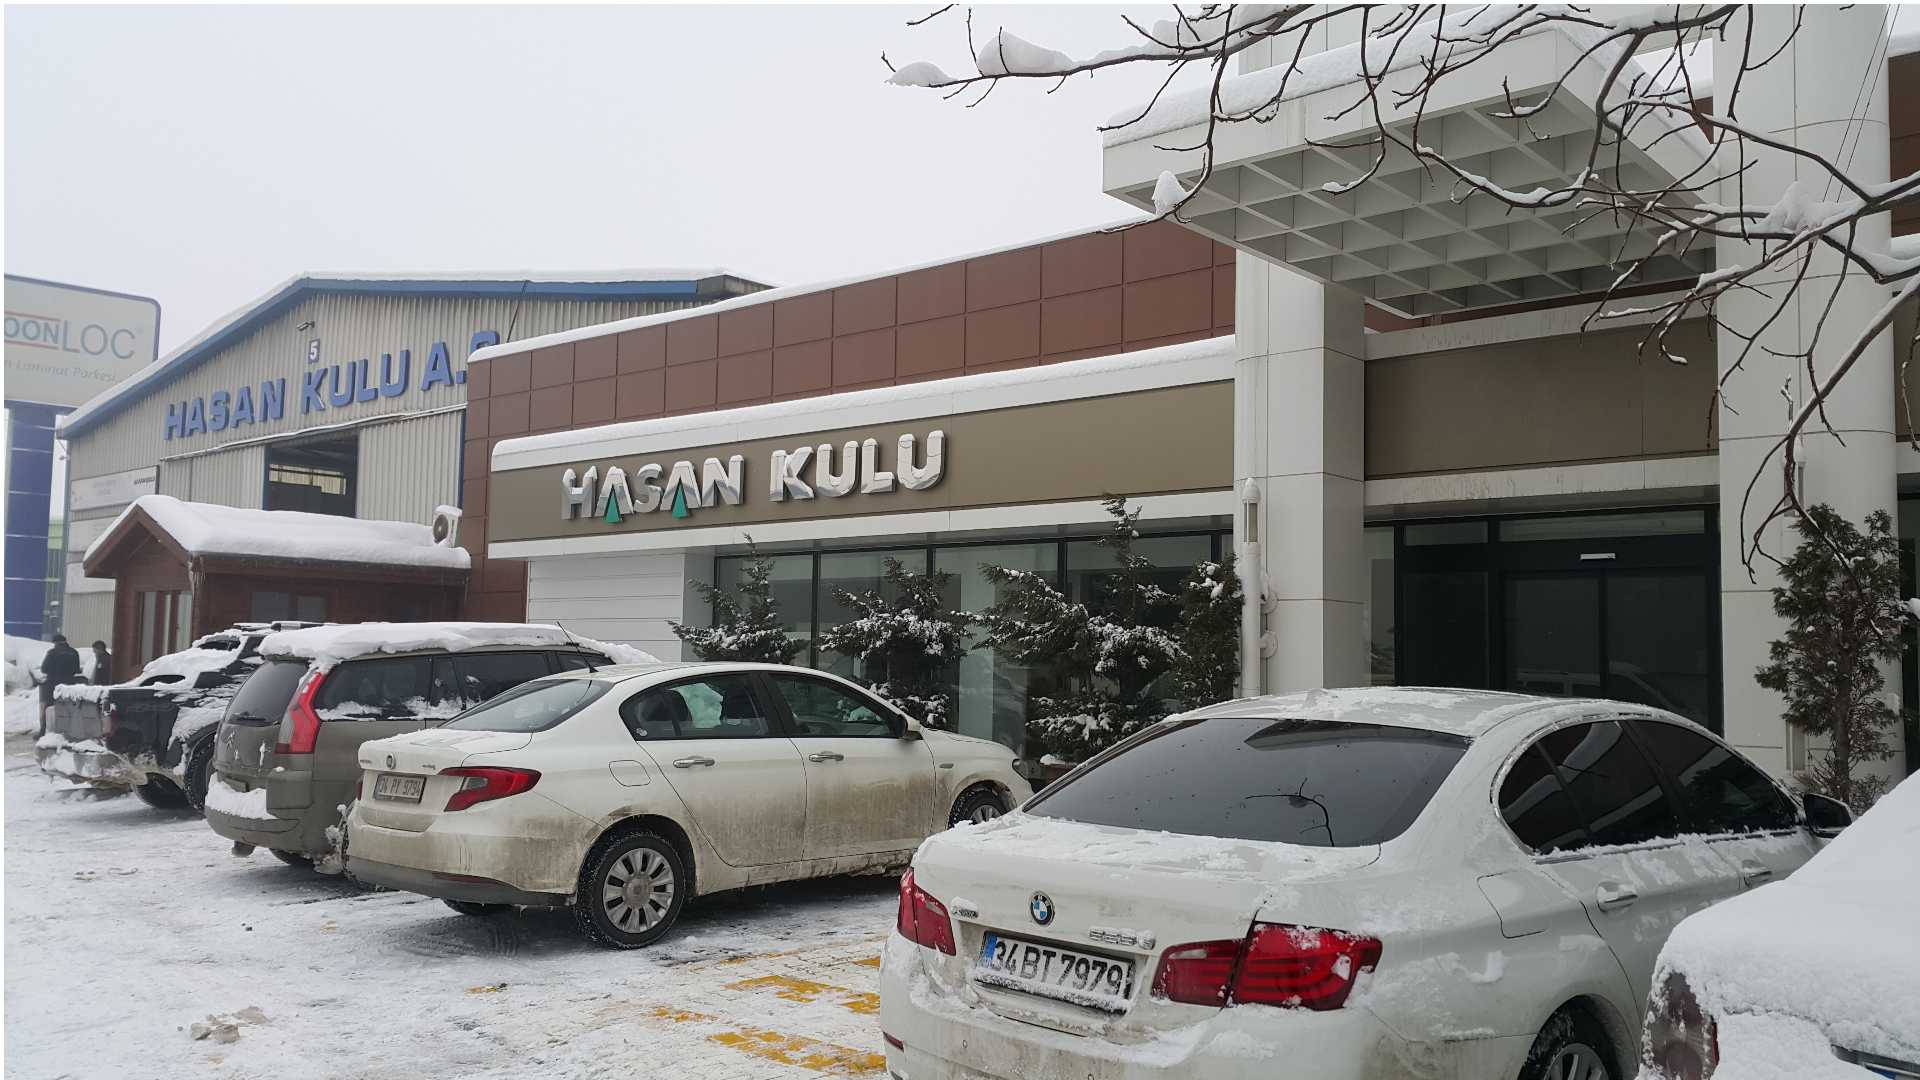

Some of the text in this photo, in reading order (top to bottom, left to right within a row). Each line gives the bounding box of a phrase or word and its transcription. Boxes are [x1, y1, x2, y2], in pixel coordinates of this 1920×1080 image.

[309, 342, 318, 361] 5
[164, 378, 286, 440] HASAN
[301, 349, 409, 415] KULU
[561, 430, 946, 523] HASAN KULU
[991, 940, 1123, 996] 34 BT 7979
